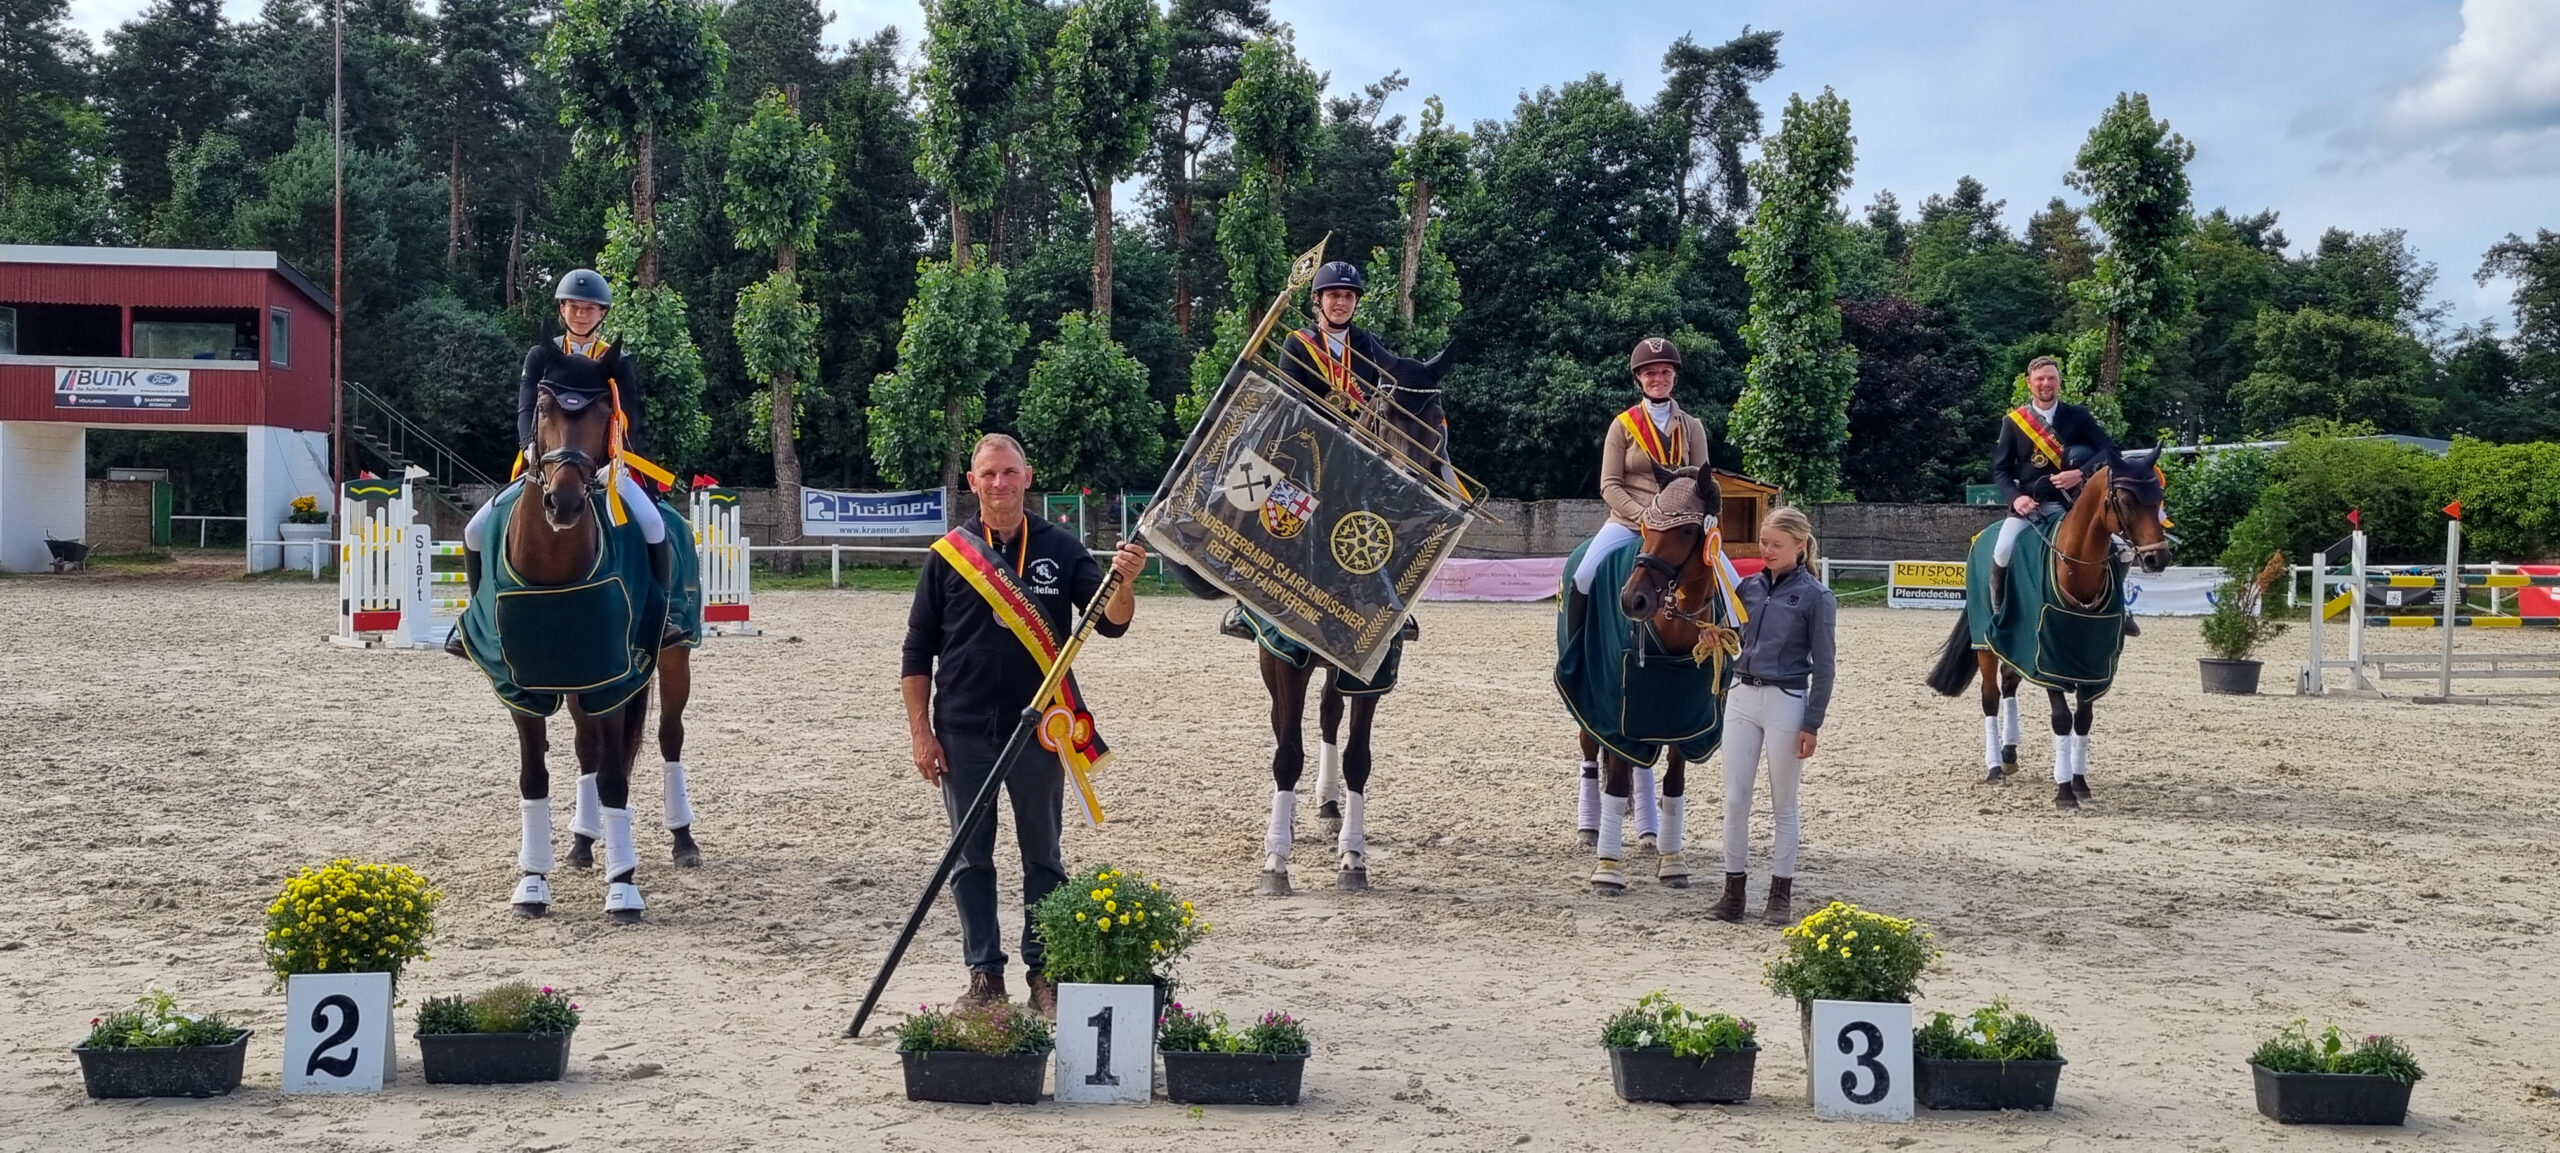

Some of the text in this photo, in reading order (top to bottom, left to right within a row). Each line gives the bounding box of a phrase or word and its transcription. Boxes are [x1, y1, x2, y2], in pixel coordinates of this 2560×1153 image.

[149, 372, 176, 385] Ford
[839, 526, 910, 534] www.kraemer.de
[846, 501, 937, 516] Krämer
[1189, 502, 1276, 570] LANDESVERBAND
[415, 534, 425, 602] Start
[1896, 588, 1961, 599] Pferdedecken
[1897, 564, 1965, 578] REITSPOR
[994, 567, 1057, 647] Saarlandmeister
[1252, 572, 1324, 626] FAHRVEREINE
[305, 994, 360, 1078] 2
[1085, 1006, 1120, 1086] 1
[1837, 1021, 1891, 1106] 3
